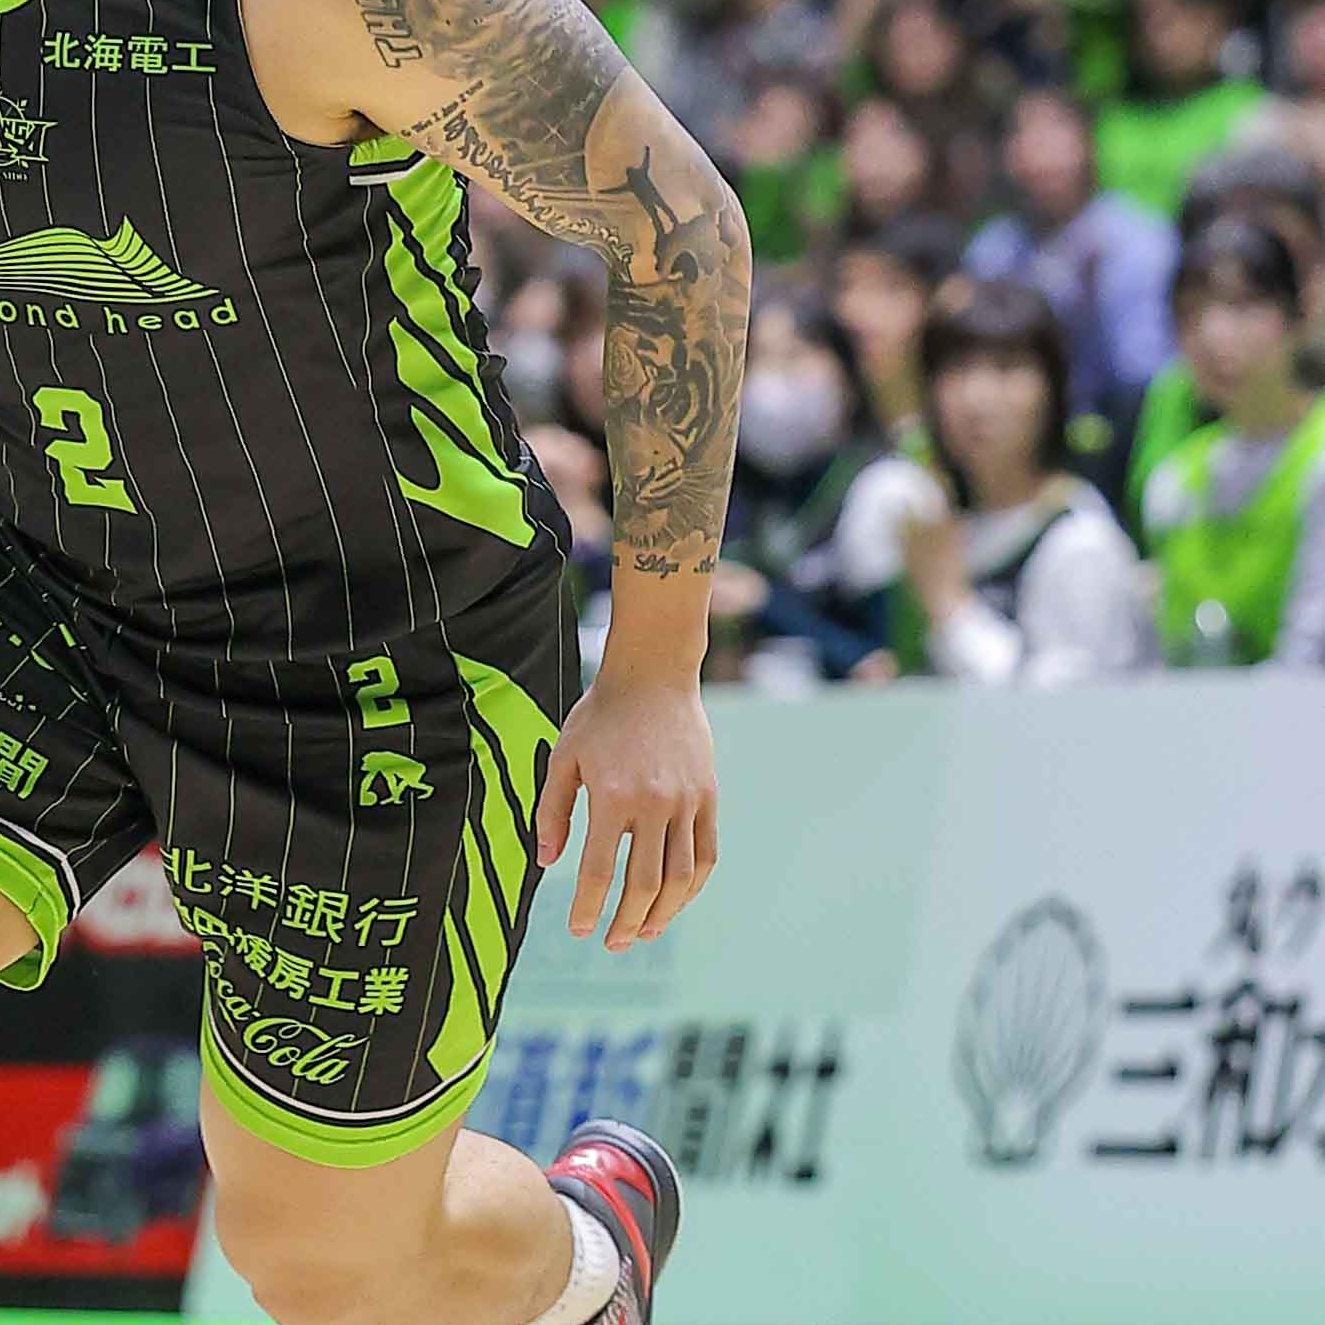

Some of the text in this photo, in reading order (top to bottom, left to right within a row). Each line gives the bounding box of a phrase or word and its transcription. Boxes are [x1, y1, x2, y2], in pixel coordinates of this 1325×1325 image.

[42, 31, 217, 74] 北海電工
[103, 297, 239, 334] head
[32, 386, 139, 515] 2
[346, 655, 412, 730] 2
[160, 846, 419, 948] 北洋銀行
